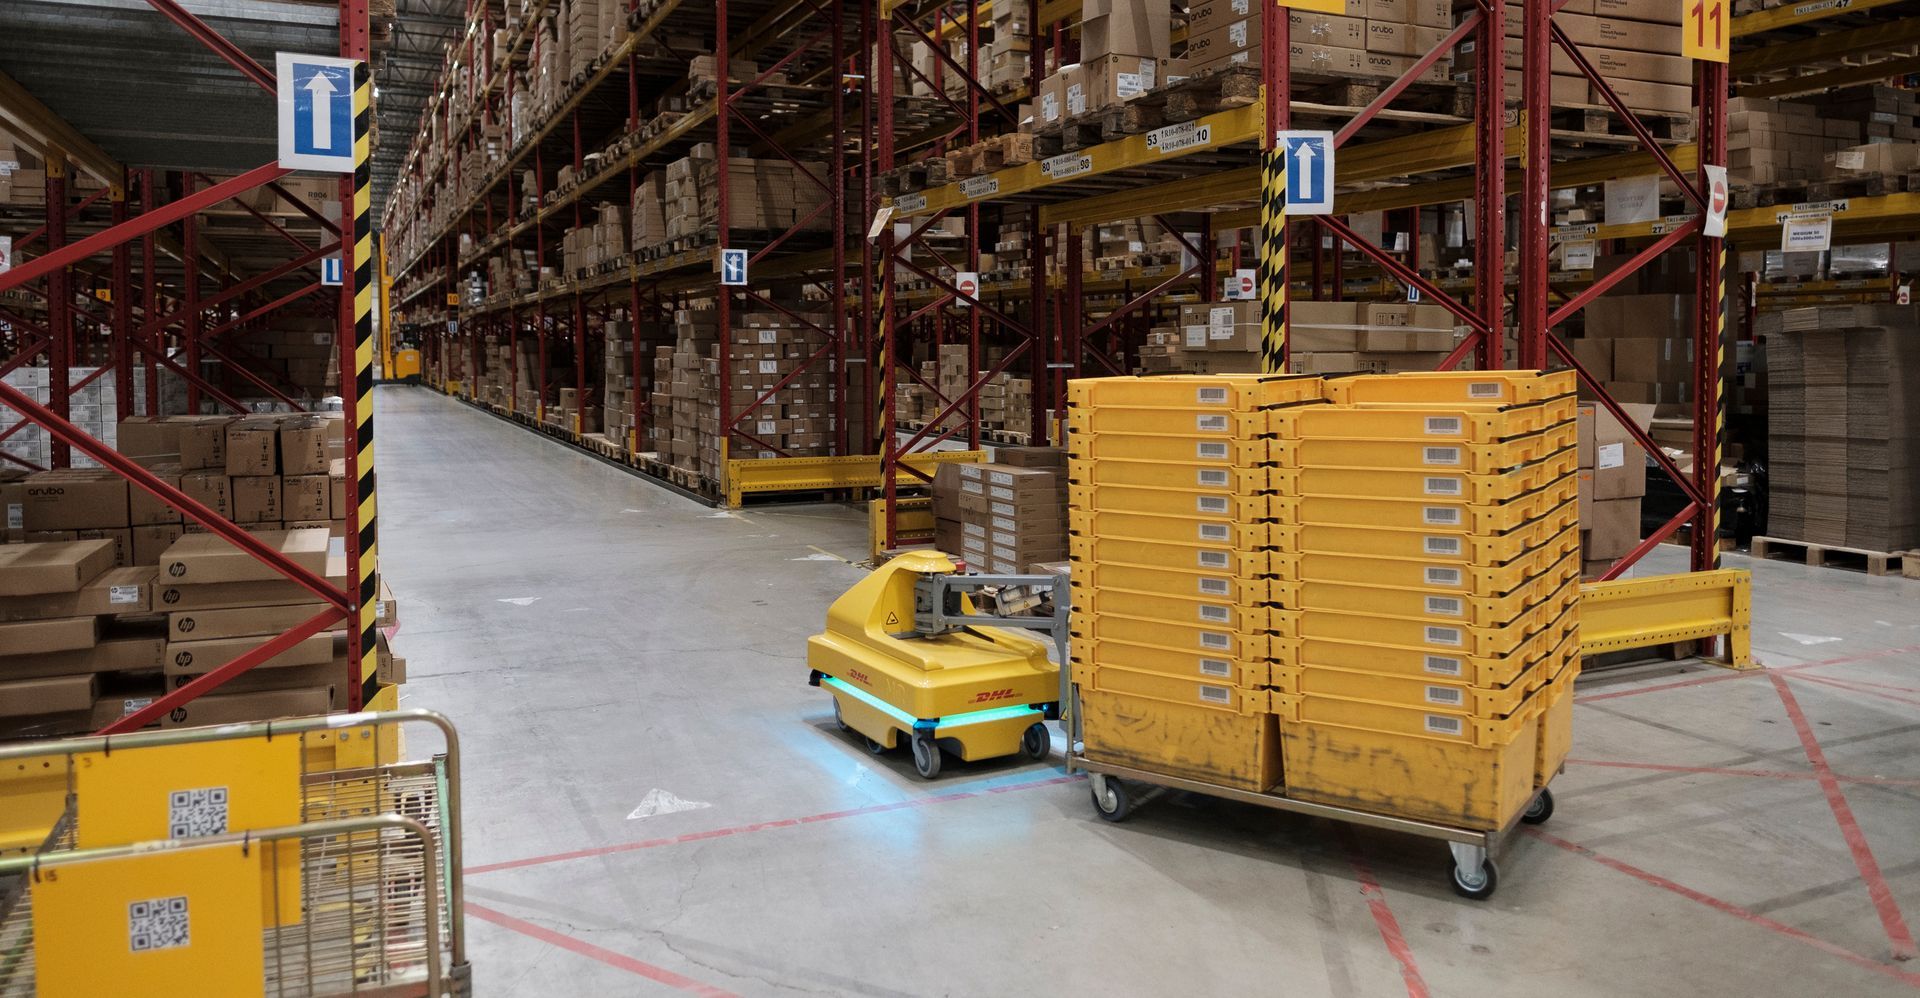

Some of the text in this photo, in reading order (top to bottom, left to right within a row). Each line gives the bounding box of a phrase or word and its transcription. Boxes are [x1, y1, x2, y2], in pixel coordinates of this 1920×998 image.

[1191, 8, 1212, 21] aruba
[1371, 24, 1393, 34] aruba
[1691, 1, 1721, 50] 11
[1189, 39, 1211, 52] aruba
[1369, 57, 1391, 66] aruba
[1147, 123, 1208, 146] 53 R10-078-02 10
[1164, 137, 1192, 150] R10-078-01
[1041, 162, 1051, 173] 80
[1832, 202, 1846, 212] 34
[1587, 226, 1596, 234] 13
[1652, 226, 1662, 234] 27
[448, 295, 458, 304] 10
[28, 487, 65, 496] aruba
[171, 562, 186, 577] hp
[164, 589, 180, 604] hp
[179, 617, 194, 632] hp
[176, 651, 192, 667] hp
[850, 668, 870, 685] DHL
[976, 688, 1016, 703] DHL
[171, 707, 187, 723] hp
